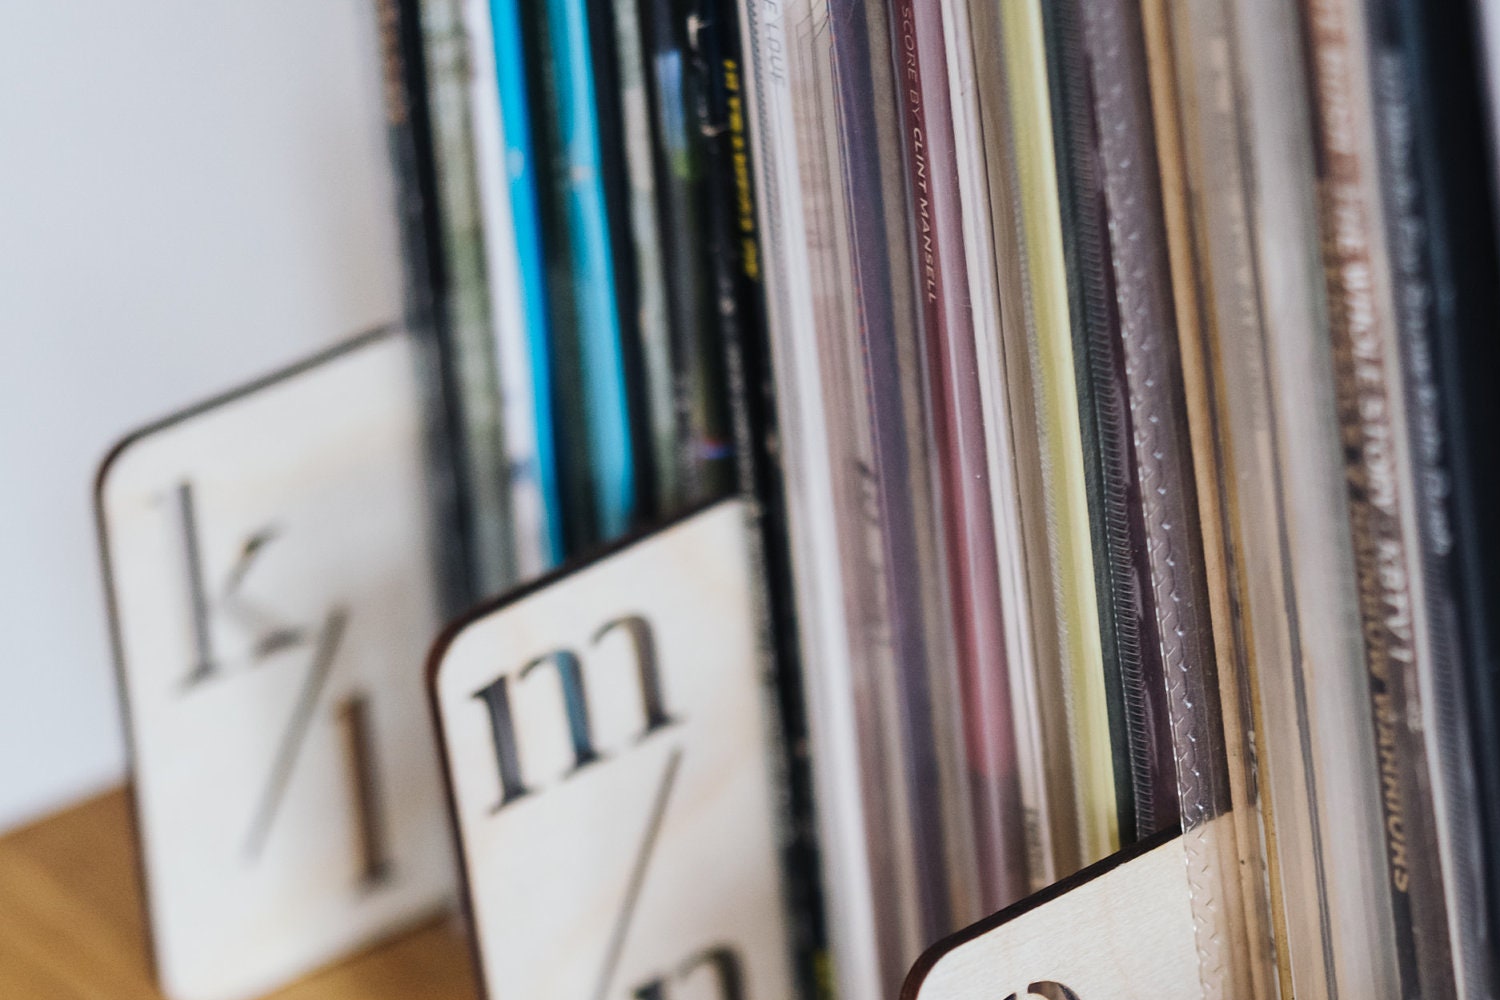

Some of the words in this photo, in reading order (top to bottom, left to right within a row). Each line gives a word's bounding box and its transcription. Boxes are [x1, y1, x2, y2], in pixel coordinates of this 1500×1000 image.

[901, 6, 918, 78] SCORE
[909, 88, 921, 120] BY
[913, 127, 927, 194] CLINT
[919, 198, 936, 304] MANSELL
